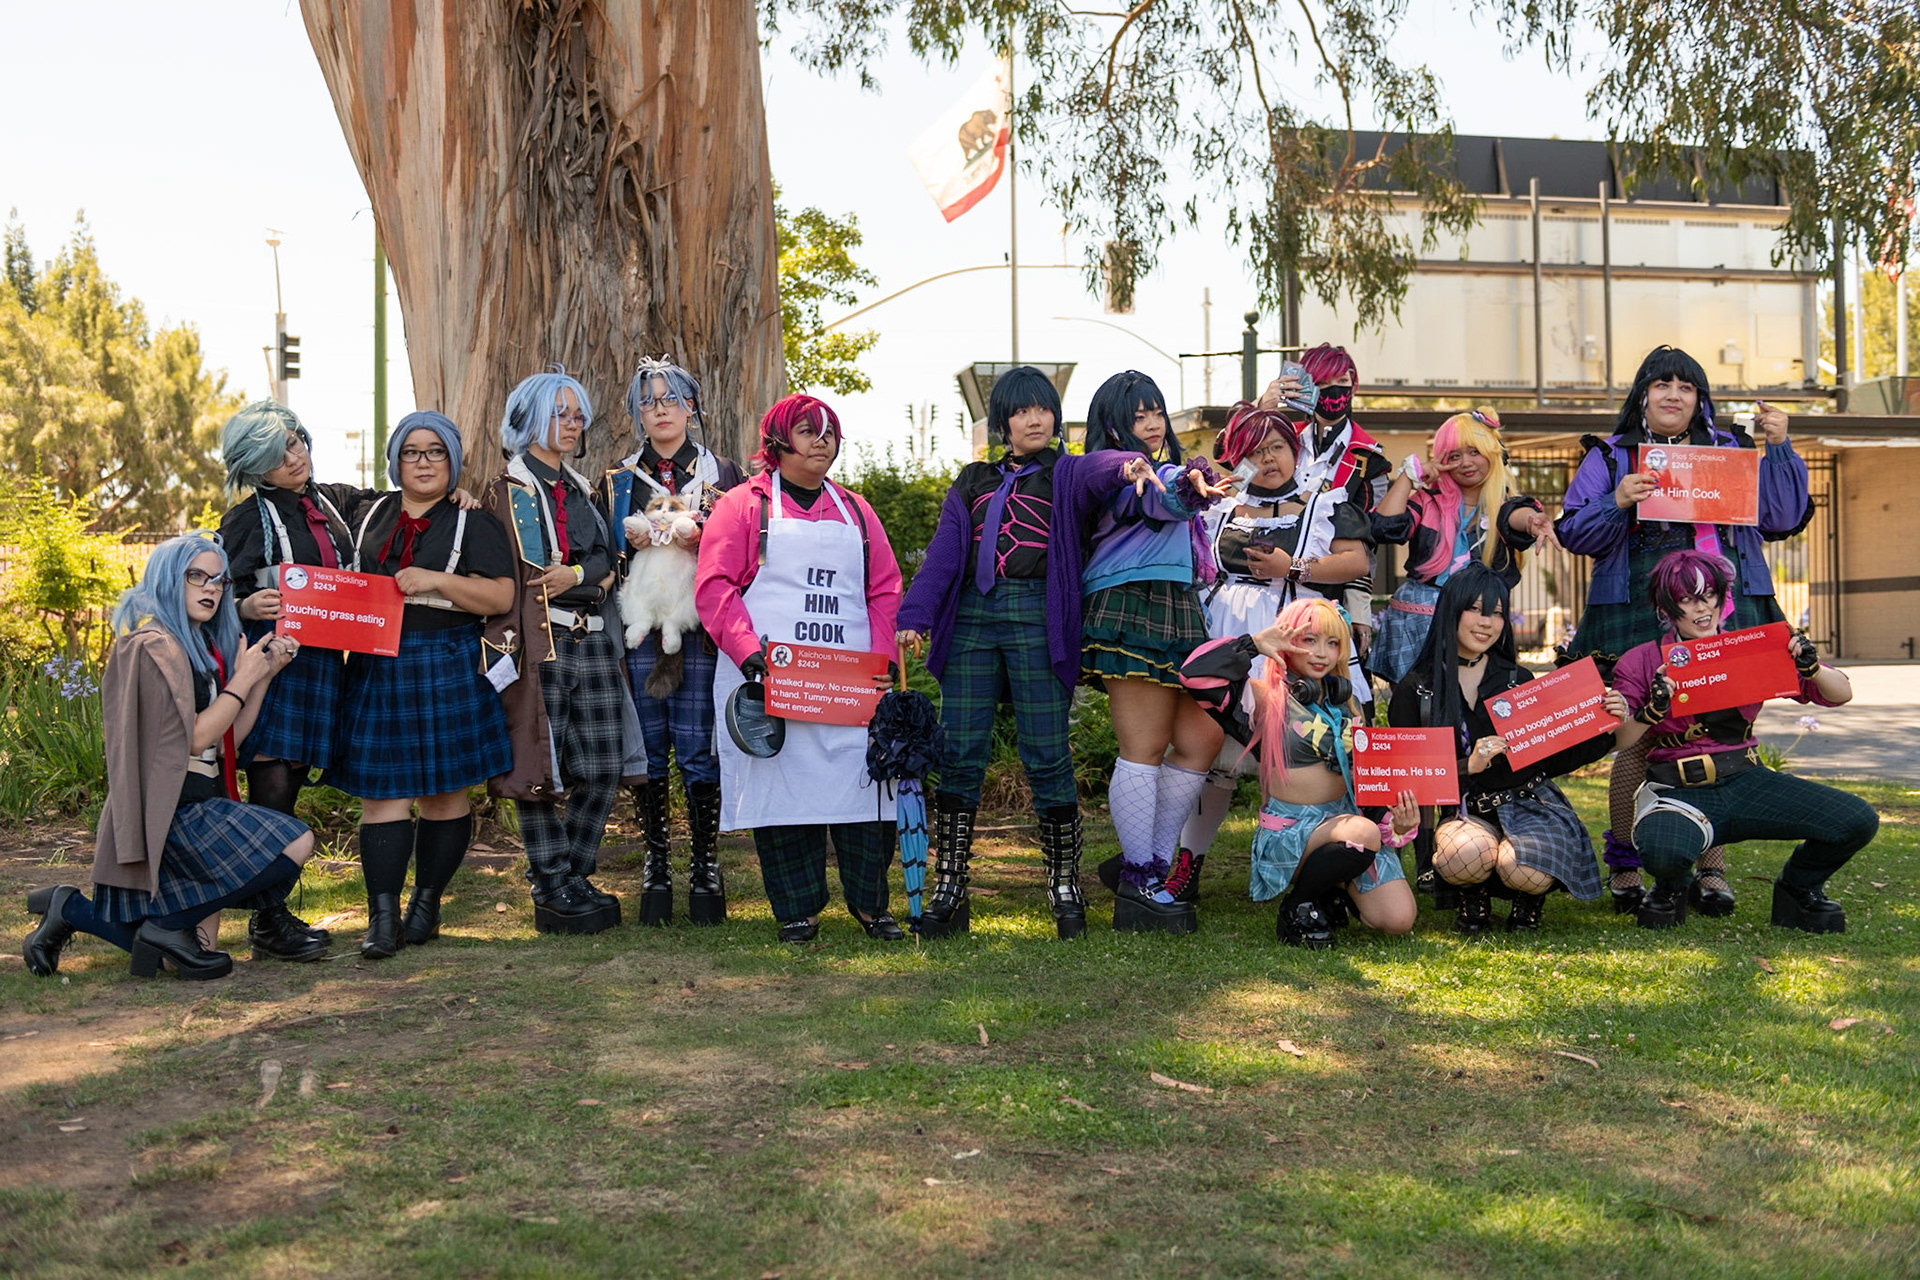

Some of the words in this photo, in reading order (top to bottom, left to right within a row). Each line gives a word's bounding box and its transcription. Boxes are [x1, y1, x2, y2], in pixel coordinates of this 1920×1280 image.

[1647, 488, 1664, 497] et
[1668, 487, 1689, 498] Him
[1692, 488, 1720, 499] Cook
[314, 572, 333, 580] Hexs
[335, 574, 367, 587] Sicklings
[807, 568, 836, 588] LET
[314, 582, 336, 591] $2434
[805, 594, 838, 615] HIM
[286, 603, 328, 619] touching
[329, 610, 354, 621] grass
[357, 614, 385, 627] eating
[284, 621, 301, 629] ass
[795, 621, 844, 644] COOK
[1695, 638, 1722, 651] Chuuni
[1724, 631, 1766, 646] Scythekick
[798, 650, 831, 660] Kaichous
[1697, 650, 1720, 661] $2434
[798, 660, 819, 668] $2434
[776, 678, 802, 687] walked
[805, 681, 826, 690] away.
[829, 683, 840, 691] No
[842, 685, 877, 695] croissant
[1682, 676, 1706, 689] need
[1709, 673, 1727, 685] pee
[780, 690, 801, 699] hand.
[803, 692, 831, 704] Tummy
[1513, 685, 1541, 700] Melocos
[771, 700, 790, 709] heart
[792, 704, 823, 714] emptier.
[1517, 696, 1537, 710] $2434
[1505, 730, 1514, 741] I'll
[1515, 726, 1525, 737] be
[1526, 715, 1553, 731] boogie
[1554, 705, 1578, 719] bussy
[1579, 695, 1602, 709] sussy
[1510, 741, 1530, 754] baka
[1531, 734, 1546, 746] slay
[1547, 722, 1573, 738] queen
[1574, 711, 1596, 726] sachi
[1357, 766, 1369, 776] Vox
[1371, 767, 1391, 776] killed
[1410, 767, 1423, 775] He
[1425, 767, 1432, 775] is
[1358, 782, 1390, 793] powerful.
